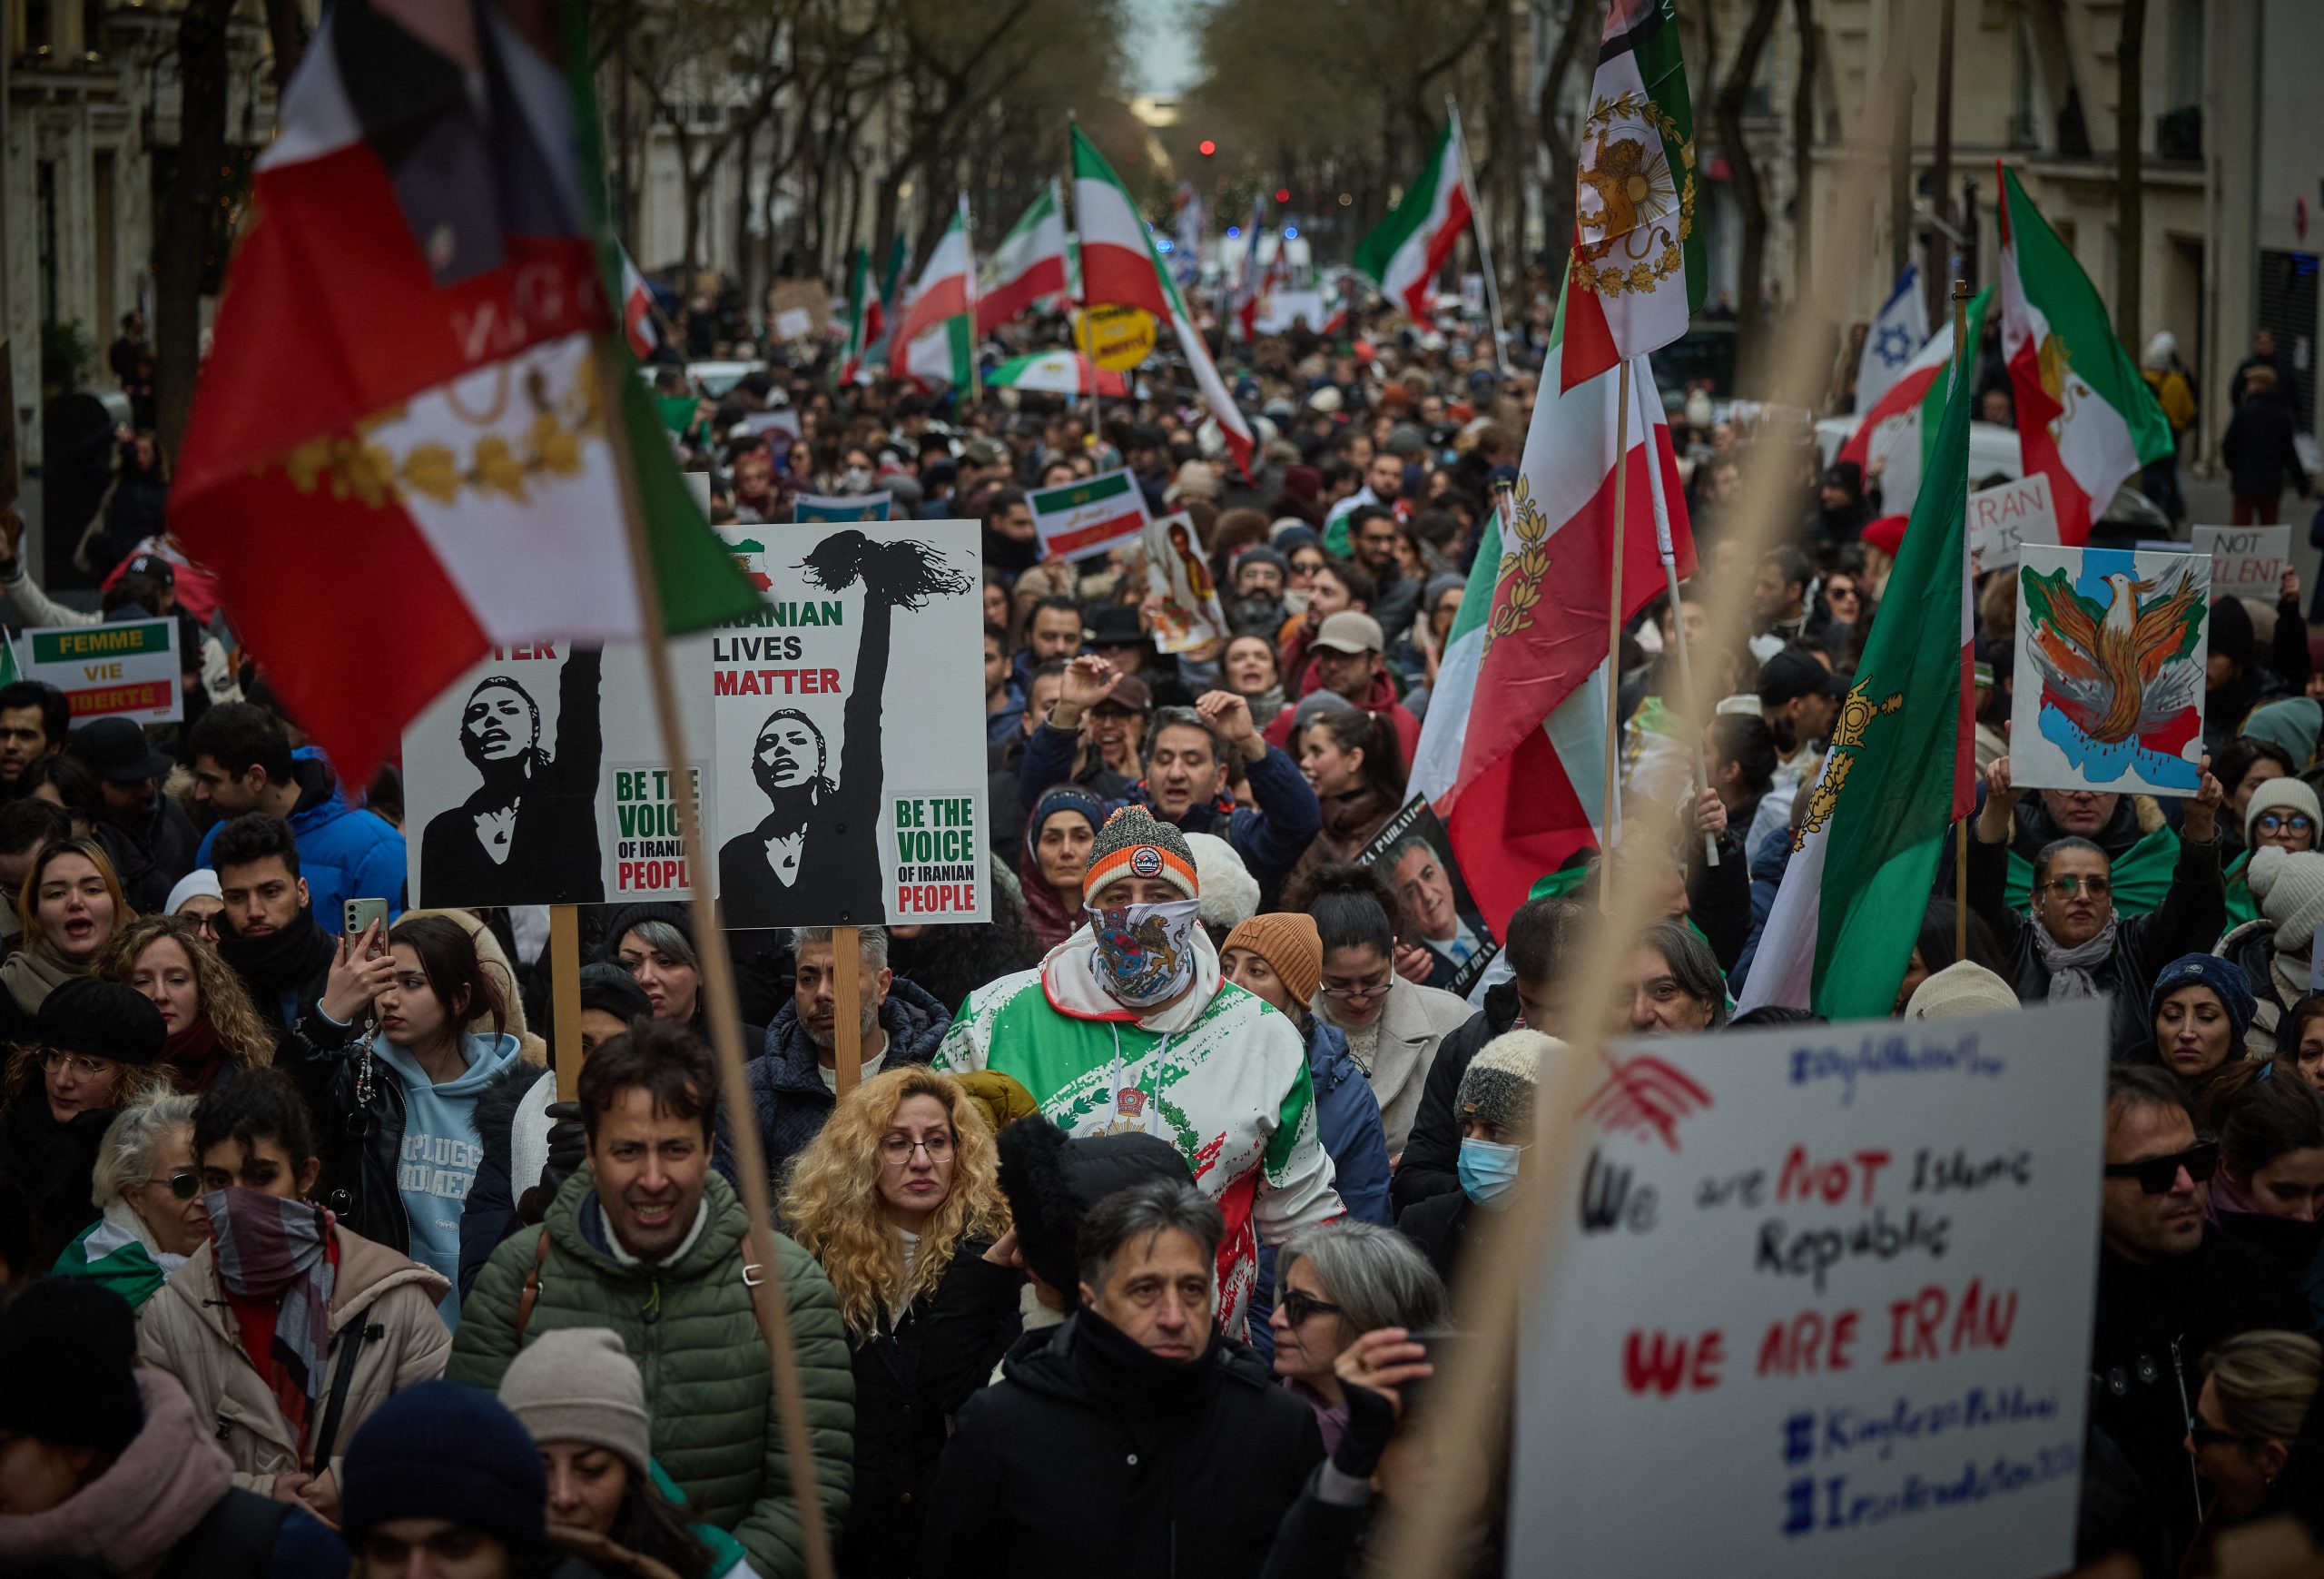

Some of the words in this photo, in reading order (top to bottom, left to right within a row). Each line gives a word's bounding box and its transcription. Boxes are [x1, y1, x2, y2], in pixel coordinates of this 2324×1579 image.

[2212, 532, 2263, 554] NOT
[2211, 558, 2284, 584] ILENT
[717, 601, 842, 628] ANIAN
[59, 628, 144, 655] FEMME
[714, 636, 803, 662] LIVES
[84, 663, 123, 682] VIE
[714, 668, 842, 696] MATTER
[69, 684, 155, 712] IBERTÉ
[616, 771, 647, 801] BE
[896, 799, 925, 828] BE
[930, 798, 973, 827] THE
[1374, 807, 1417, 854] PAHLAVI
[618, 841, 636, 859] OF
[640, 840, 690, 858] IRANI
[897, 830, 974, 863] VOICE
[618, 860, 693, 891] PEOPL
[898, 866, 915, 883] OF
[918, 864, 975, 882] IRANIAN
[899, 883, 976, 913] PEOPLE
[1454, 964, 1471, 986] OF
[1471, 942, 1497, 971] IRAN
[1580, 1146, 1659, 1236] We
[1695, 1168, 1766, 1209] are
[1776, 1141, 1891, 1205] NOT
[1756, 1209, 1953, 1294] Republic
[1621, 1327, 1725, 1399] WE
[1756, 1308, 1859, 1378] ARE
[1884, 1275, 2019, 1364] IRAN
